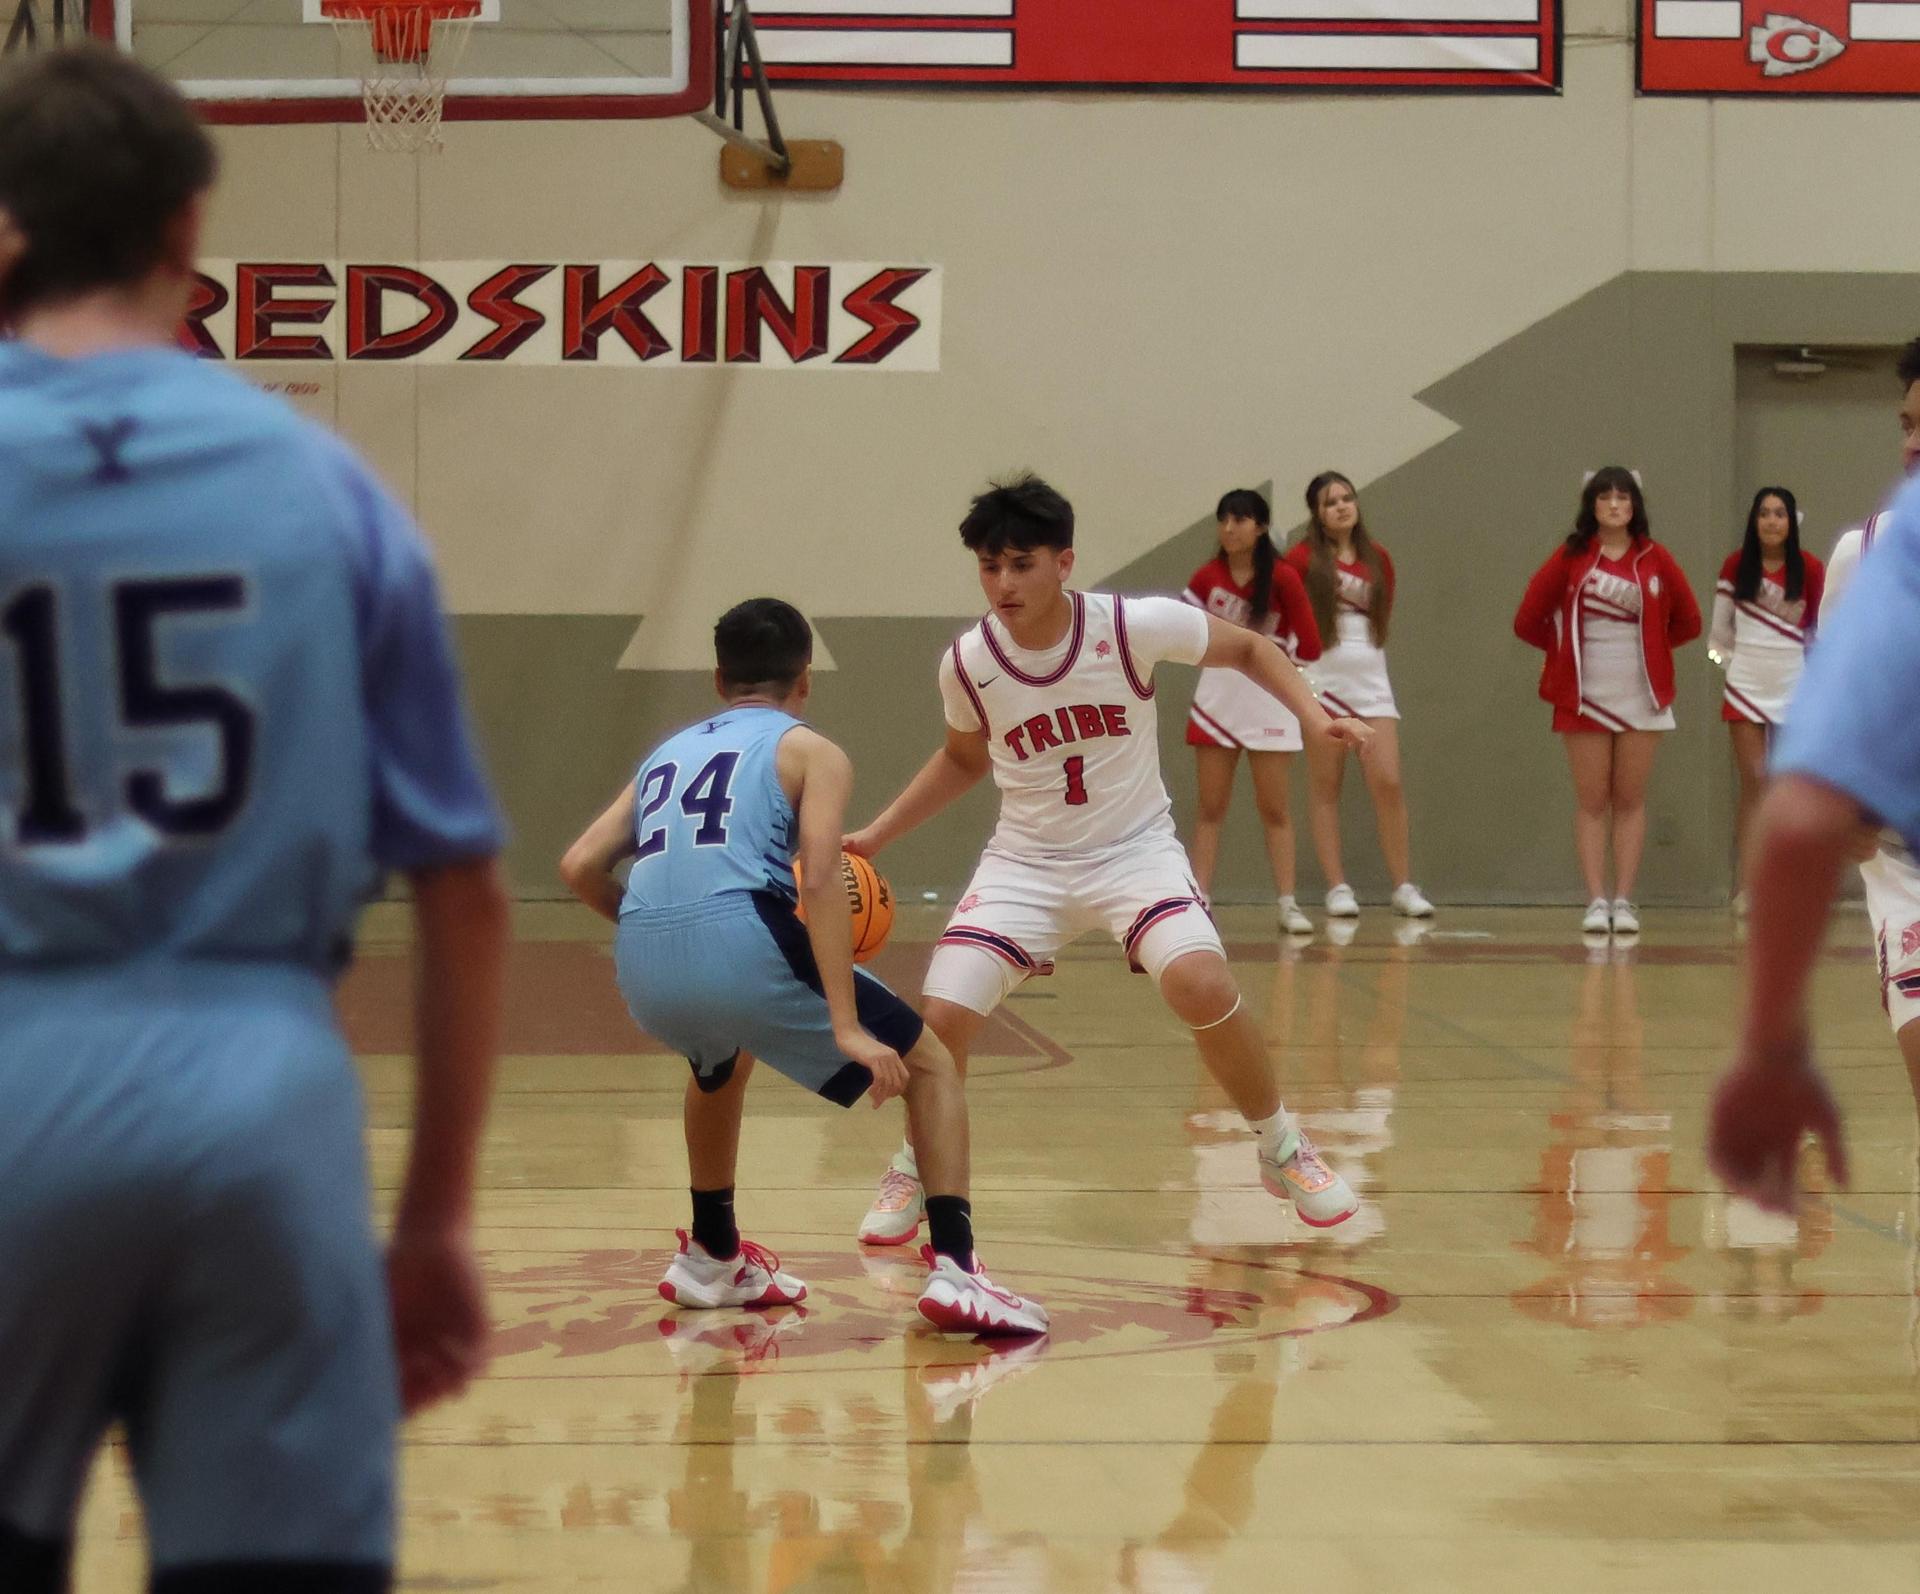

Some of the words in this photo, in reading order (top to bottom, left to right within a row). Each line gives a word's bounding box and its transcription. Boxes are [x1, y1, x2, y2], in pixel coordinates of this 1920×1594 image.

[1, 574, 257, 846] 15
[1004, 704, 1132, 761] TRIBE
[634, 750, 744, 863] 24
[1063, 755, 1088, 805] 1
